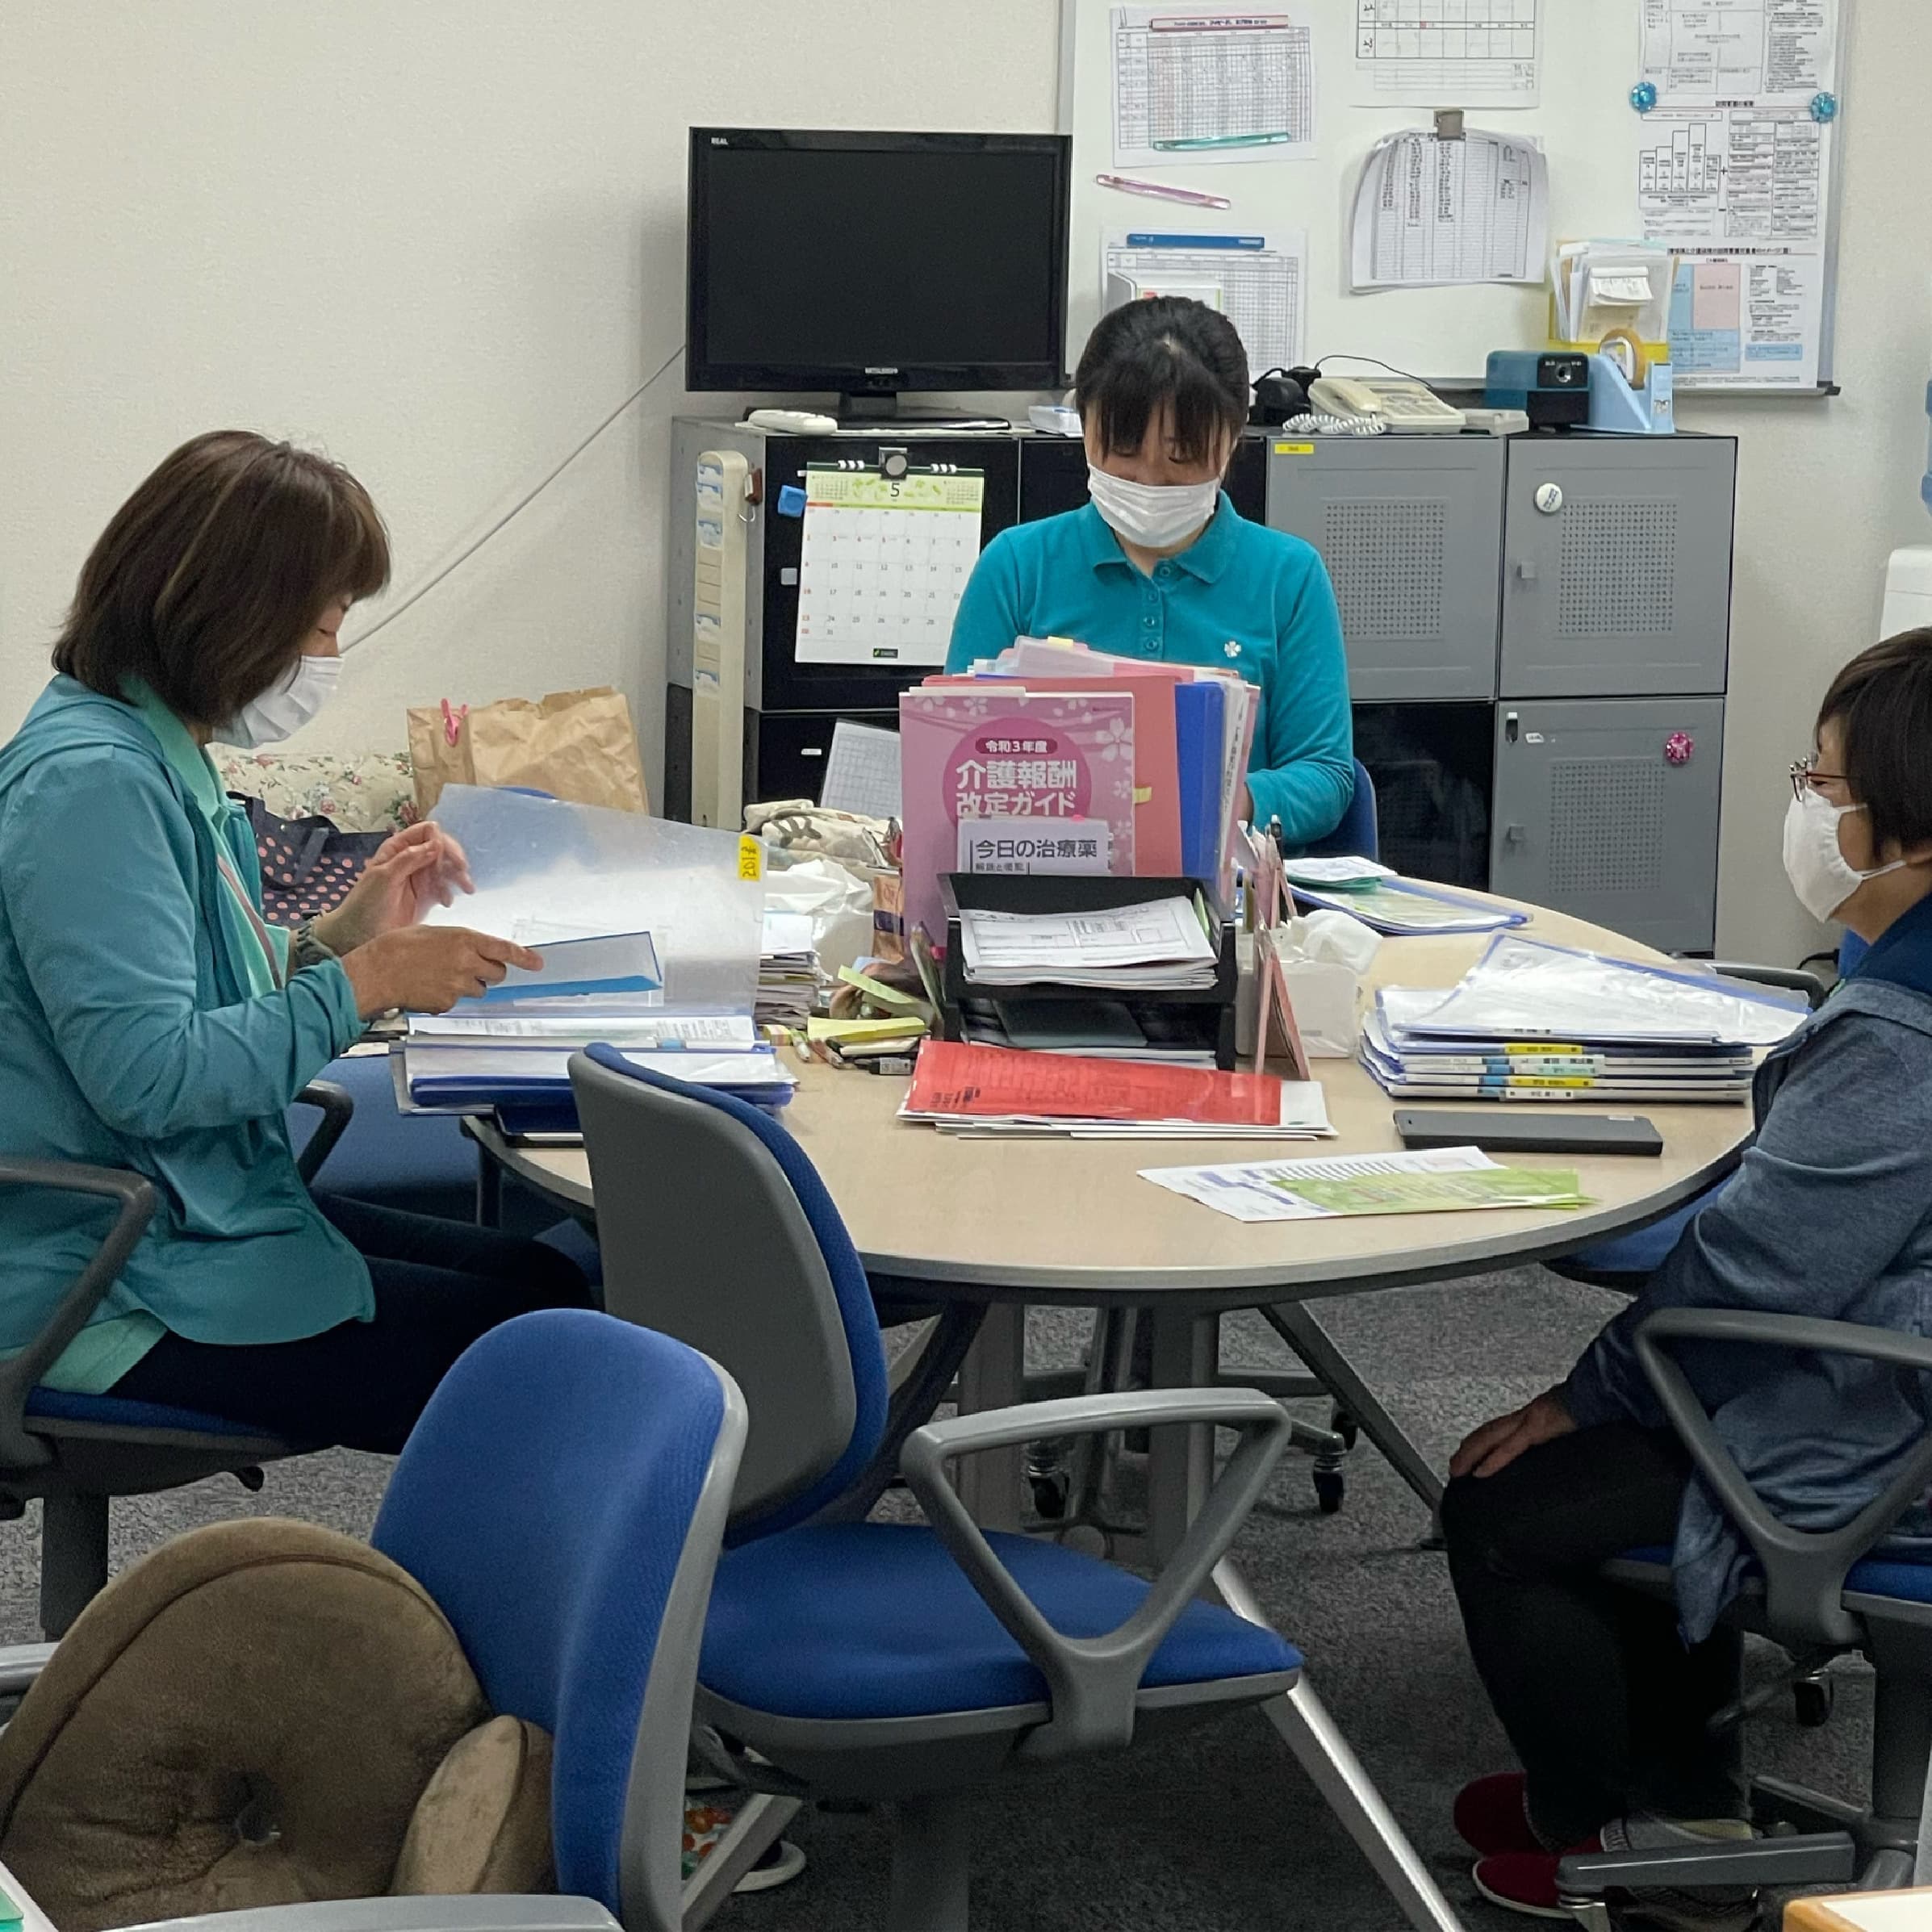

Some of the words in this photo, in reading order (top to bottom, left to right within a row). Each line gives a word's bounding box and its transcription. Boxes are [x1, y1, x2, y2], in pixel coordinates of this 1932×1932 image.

[890, 483, 900, 498] 5
[985, 740, 1048, 753] 令和3年度
[956, 759, 1077, 789] 介護報酬
[956, 791, 1076, 816] 改定ガイド
[976, 839, 1098, 859] 今日の治療薬
